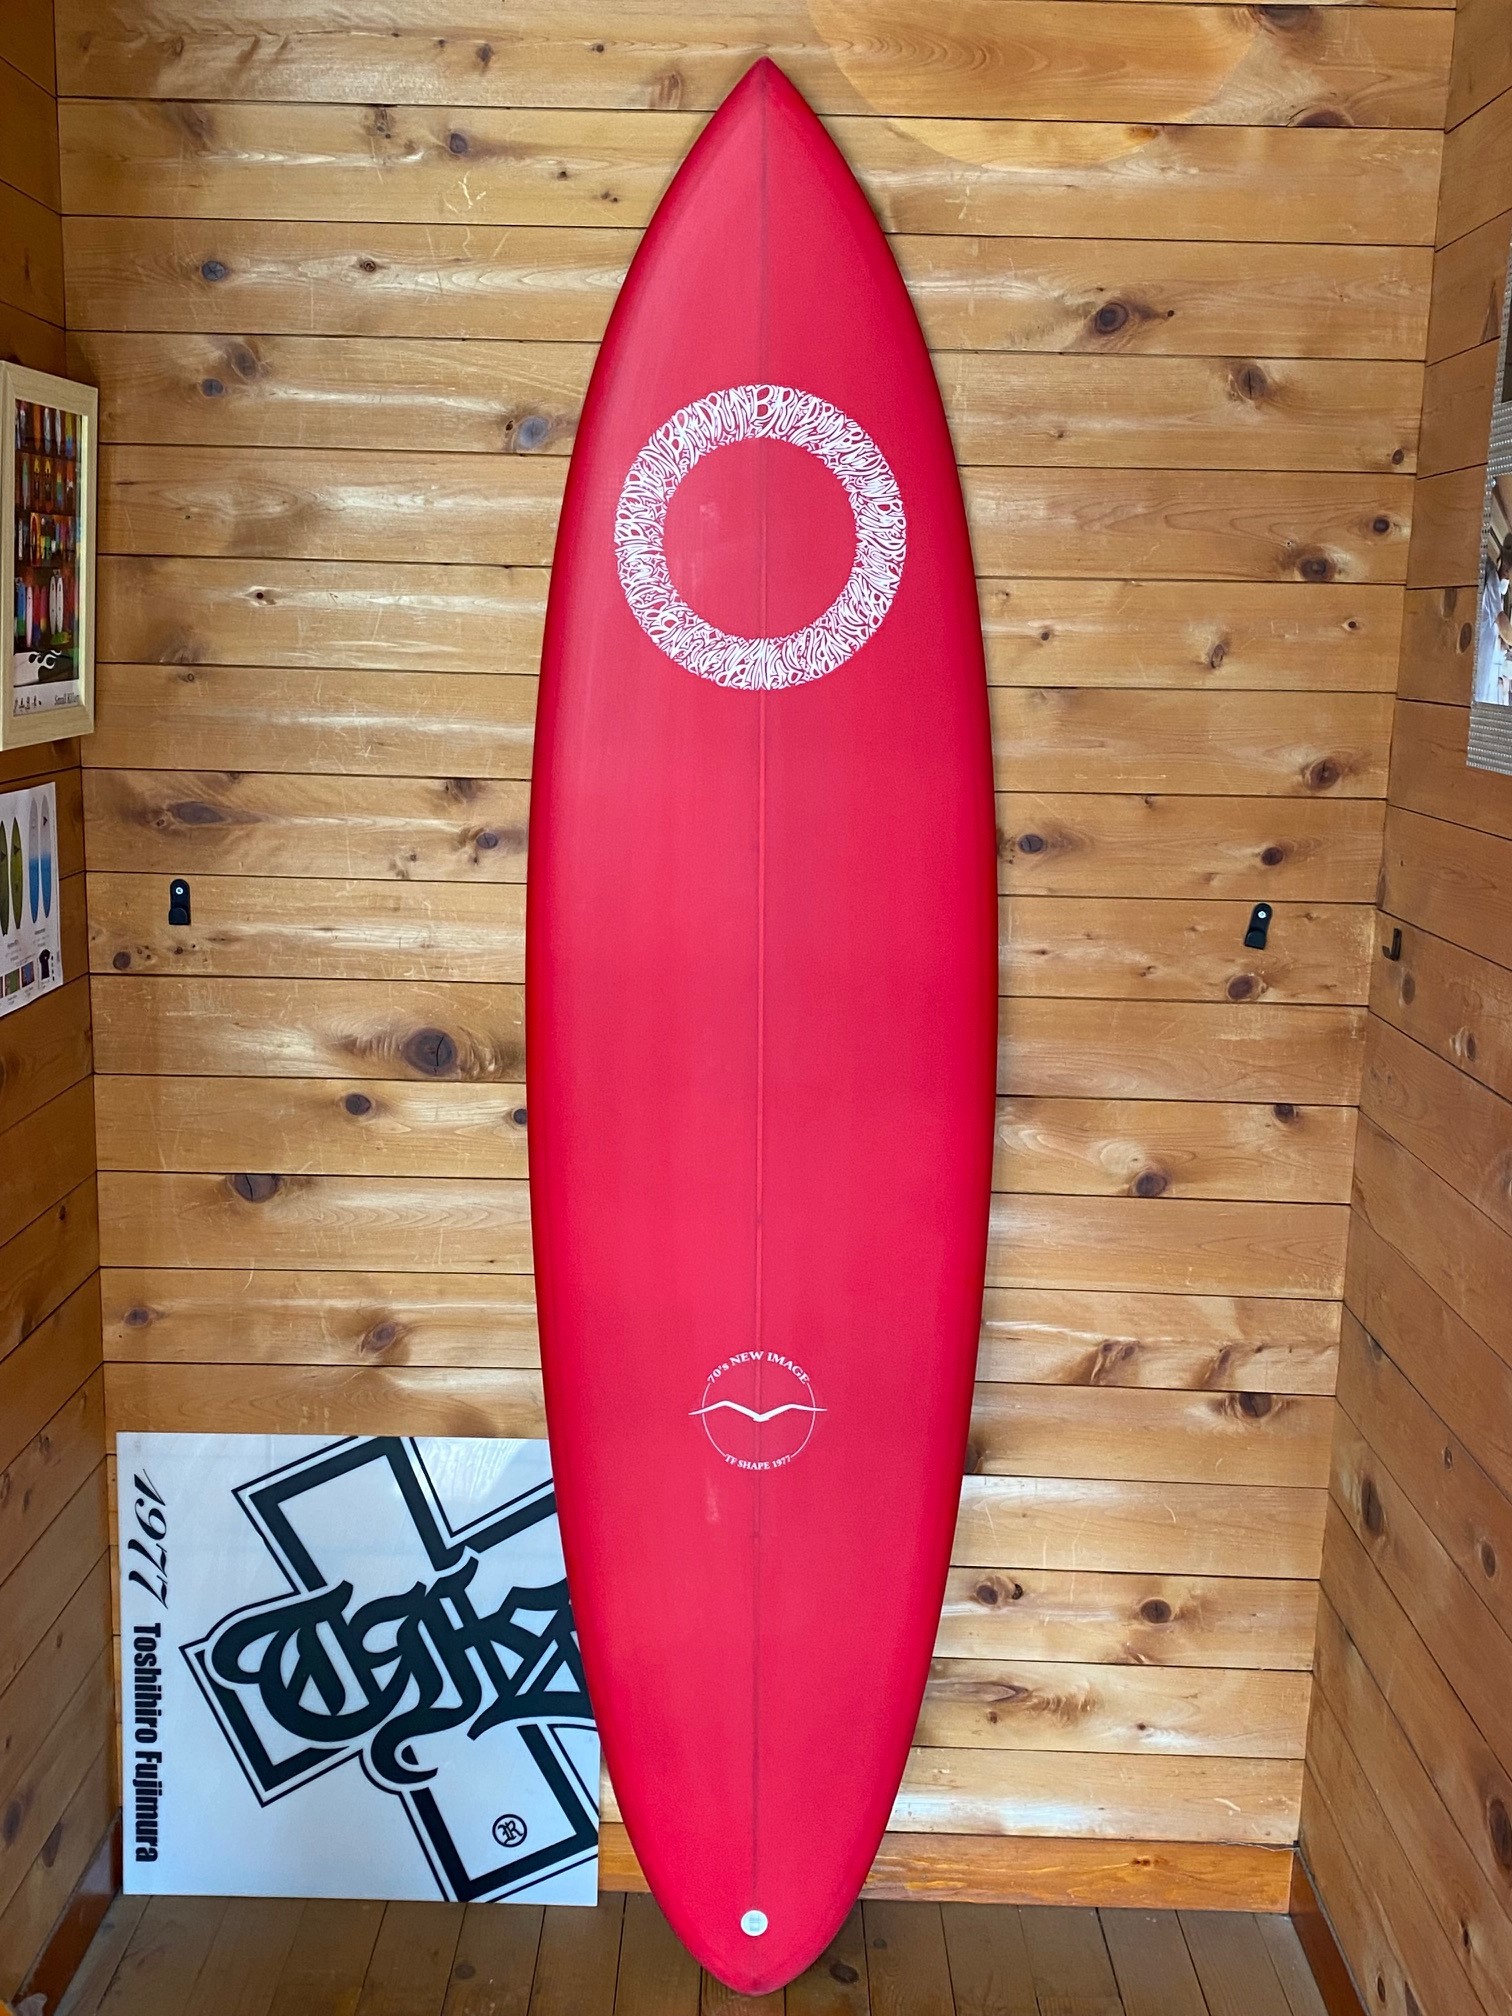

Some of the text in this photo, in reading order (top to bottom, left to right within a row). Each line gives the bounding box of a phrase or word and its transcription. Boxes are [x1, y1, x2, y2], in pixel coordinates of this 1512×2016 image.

[707, 1351, 810, 1385] 70's NEW IMAGE
[725, 1453, 792, 1471] TF SHAPE 1977
[128, 1469, 168, 1863] 1977 Toshihiro Fujimura
